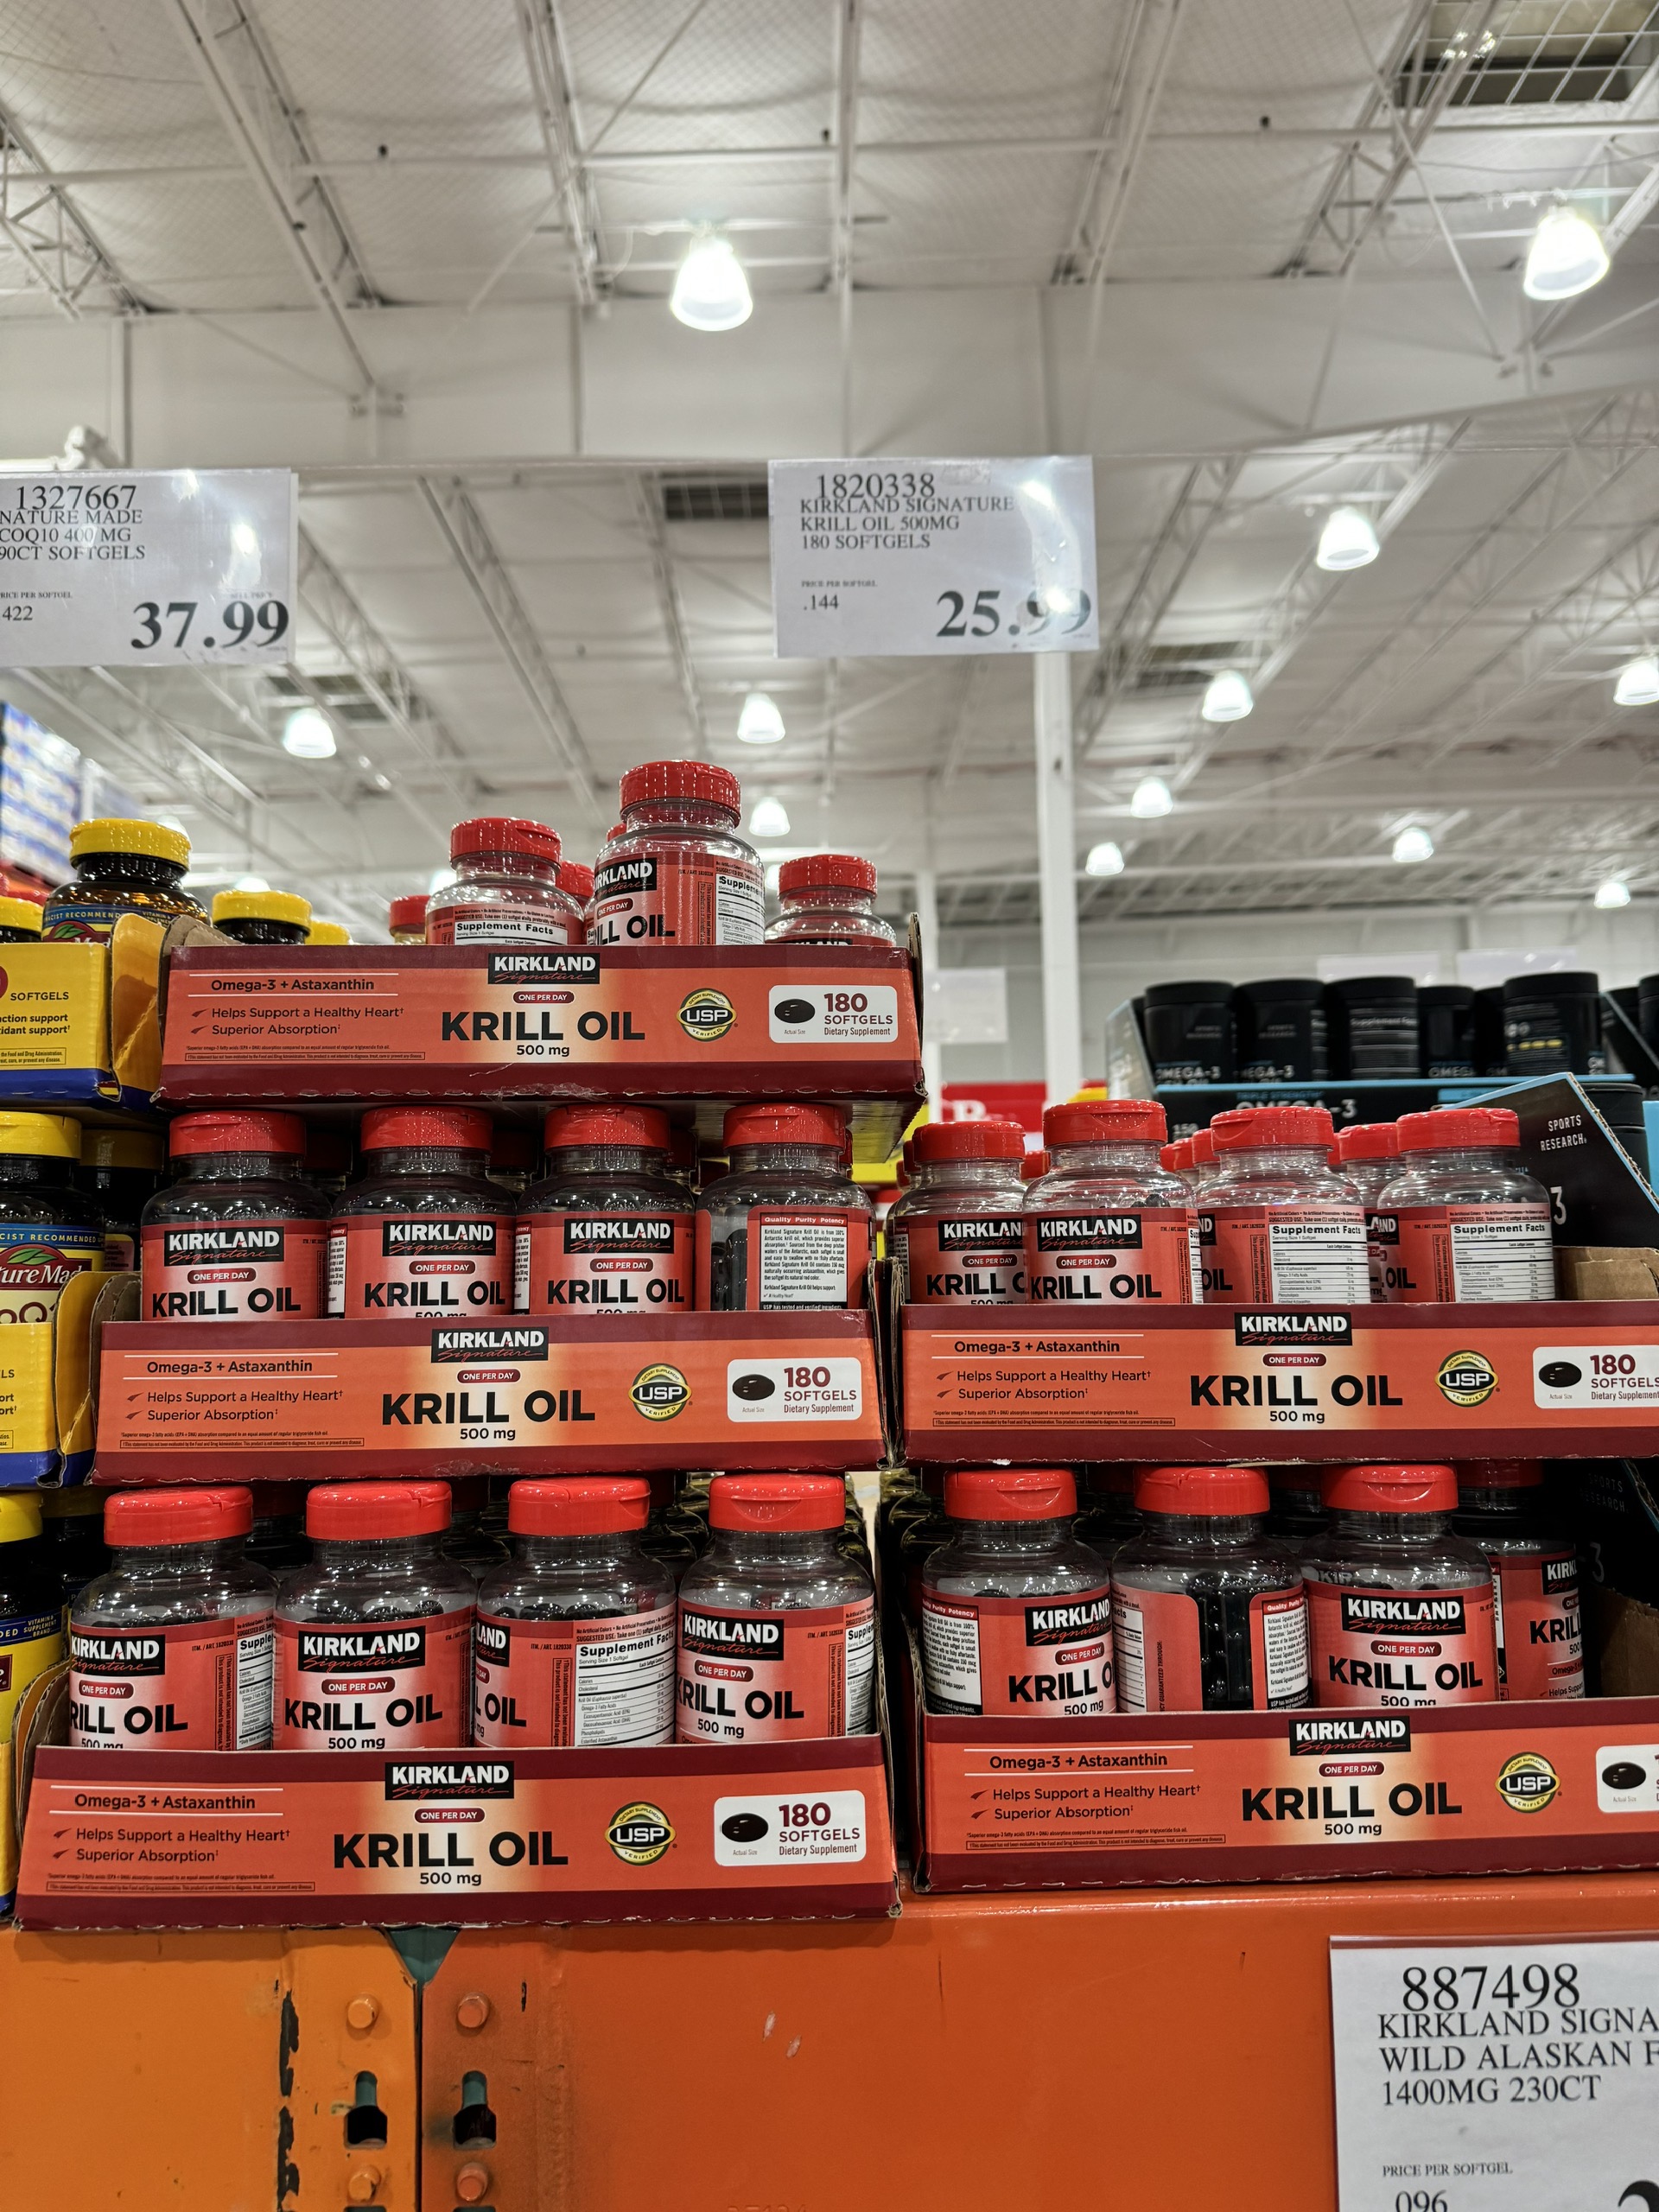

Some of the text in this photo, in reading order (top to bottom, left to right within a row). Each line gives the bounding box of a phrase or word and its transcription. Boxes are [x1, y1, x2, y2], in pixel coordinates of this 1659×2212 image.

[817, 474, 935, 499] 1820338
[16, 486, 137, 510] 1327667
[801, 497, 1014, 513] KIRKLAND SIGNATURE
[0, 510, 143, 524] NATURE MADE
[801, 516, 959, 531] KRILL OIL 500MG
[0, 528, 130, 544] COQ10 400 MG
[802, 535, 931, 550] 180 SOFTGELS
[0, 545, 145, 560] 90CT SOFTGELS
[804, 594, 839, 610] .144
[130, 601, 289, 649] 37.99
[456, 923, 553, 935] Supplement Facts
[626, 914, 676, 938] OIL
[494, 957, 596, 971] KIRKLAND
[211, 978, 375, 992] Omega-3 Astaxanthin
[494, 971, 595, 984] Signature
[10, 992, 69, 1001] SOFTGELS
[823, 993, 868, 1013] 180
[29, 1014, 68, 1024] support
[212, 1007, 246, 1020] Helps
[249, 1007, 300, 1020] Support
[314, 1007, 361, 1020] Healthy
[686, 1009, 728, 1022] USP
[824, 1014, 893, 1025] SOFTGELS
[212, 1024, 264, 1037] Superior
[442, 1011, 645, 1041] KRILL OIL
[824, 1027, 890, 1037] Dietary Supplement
[517, 1045, 570, 1057] 500 mg
[1548, 1115, 1581, 1132] SPORTS
[570, 1222, 671, 1241] KIRKLAND
[1040, 1218, 1137, 1237] KIRKLAND
[30, 1234, 97, 1243] RECOMMENDED
[168, 1230, 280, 1250] KIRKLAND
[547, 1278, 685, 1304] KRILL OIL
[1031, 1274, 1162, 1300] KRILL OIL
[152, 1287, 302, 1318] KRILL OIL
[1242, 1316, 1347, 1332] KIRKLAND
[438, 1331, 544, 1349] KIRKLAND
[1242, 1332, 1348, 1346] Signature
[438, 1348, 543, 1363] Signature
[147, 1359, 313, 1374] Omega-3 Astaxanthin
[1590, 1354, 1636, 1375] 180
[784, 1367, 830, 1388] 180
[1446, 1373, 1490, 1386] USP
[1591, 1377, 1659, 1389] SOFTGELS
[639, 1386, 683, 1400] USP
[784, 1390, 857, 1402] SOFTGELS
[1191, 1375, 1403, 1406] KRILL OIL
[382, 1389, 595, 1426] KRILL OIL
[1269, 1411, 1325, 1423] 500 mg
[460, 1428, 516, 1440] 500 mg
[1348, 1599, 1461, 1620] KIRKLAND
[23, 1619, 57, 1633] SUPPLEMENT
[28, 1616, 50, 1625] VITAMIN
[33, 1628, 50, 1637] BRAND
[303, 1632, 420, 1656] KIRKLAND
[580, 1630, 674, 1657] Supplement Facts
[303, 1656, 420, 1673] Signature
[1329, 1655, 1484, 1691] KRILL OIL
[284, 1694, 443, 1731] KRILL OIL
[1296, 1720, 1406, 1741] KIRKLAND
[1296, 1739, 1406, 1757] Signature
[392, 1766, 510, 1784] KIRKLAND
[1506, 1777, 1551, 1791] USP
[392, 1784, 509, 1801] Signature
[1242, 1782, 1463, 1821] KRILL OIL
[779, 1802, 831, 1827] 180
[616, 1827, 664, 1842] USP
[779, 1827, 861, 1842] SOFTGELS
[1324, 1822, 1382, 1836] 500 mg
[334, 1831, 569, 1868] KRILL OIL
[420, 1872, 482, 1885] 500 mg
[1402, 1963, 1580, 2012] 887498
[1378, 2007, 1659, 2039] KIRKLAND SIGNA
[1379, 2046, 1466, 2073] WILD
[1477, 2041, 1631, 2071] ALASKAN
[1382, 2075, 1601, 2107] 1400MG 230CT
[1382, 2162, 1513, 2177] PRICE PER SOFTGEL
